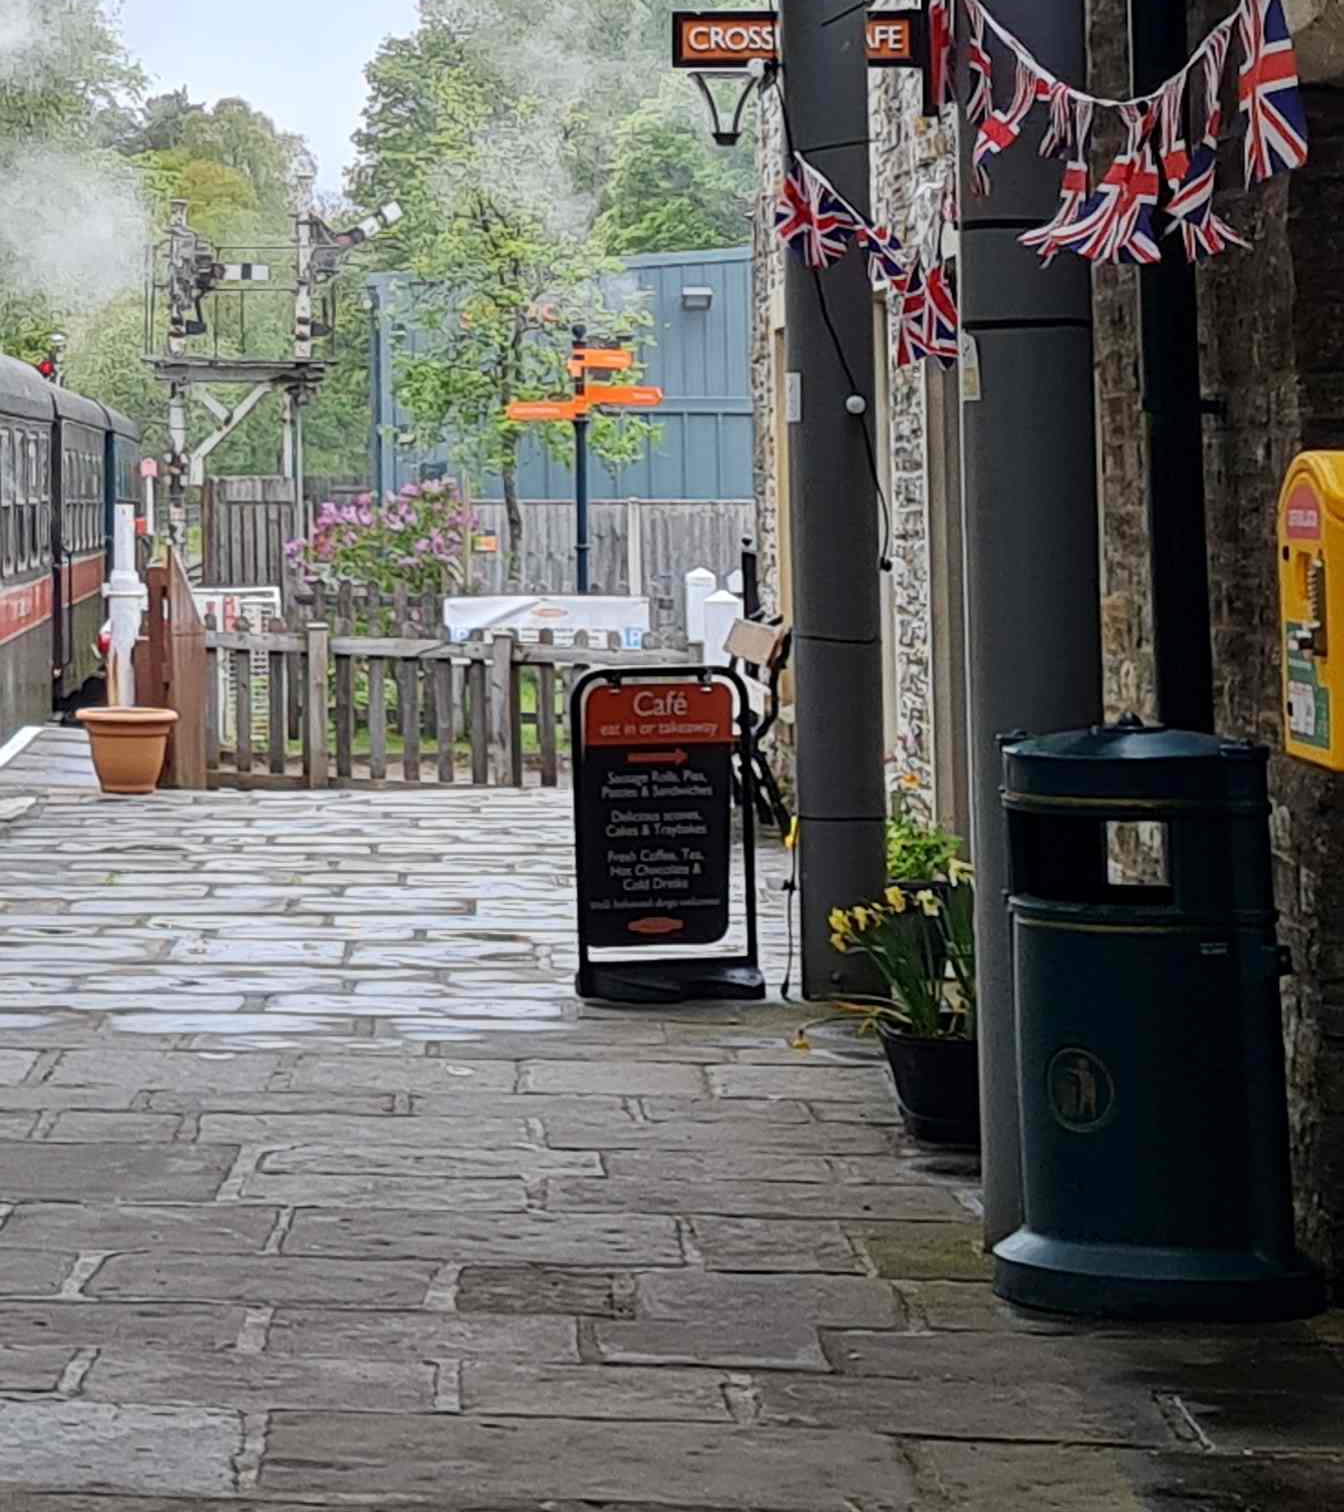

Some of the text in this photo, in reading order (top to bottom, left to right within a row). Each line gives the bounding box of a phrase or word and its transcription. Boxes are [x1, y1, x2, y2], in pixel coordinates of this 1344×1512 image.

[633, 690, 688, 716] Café
[600, 722, 719, 737] eat in or takeaway
[607, 771, 649, 786] Sausage
[641, 785, 649, 797] &
[652, 785, 713, 797] Sandwiches
[611, 810, 660, 822] Delicious
[605, 823, 708, 837] Cakes & Traybakes
[607, 850, 637, 863] Fresh
[640, 849, 679, 862] Coffee,
[609, 862, 701, 877] Hot Chocolate &
[623, 877, 688, 891] Cold Drinks
